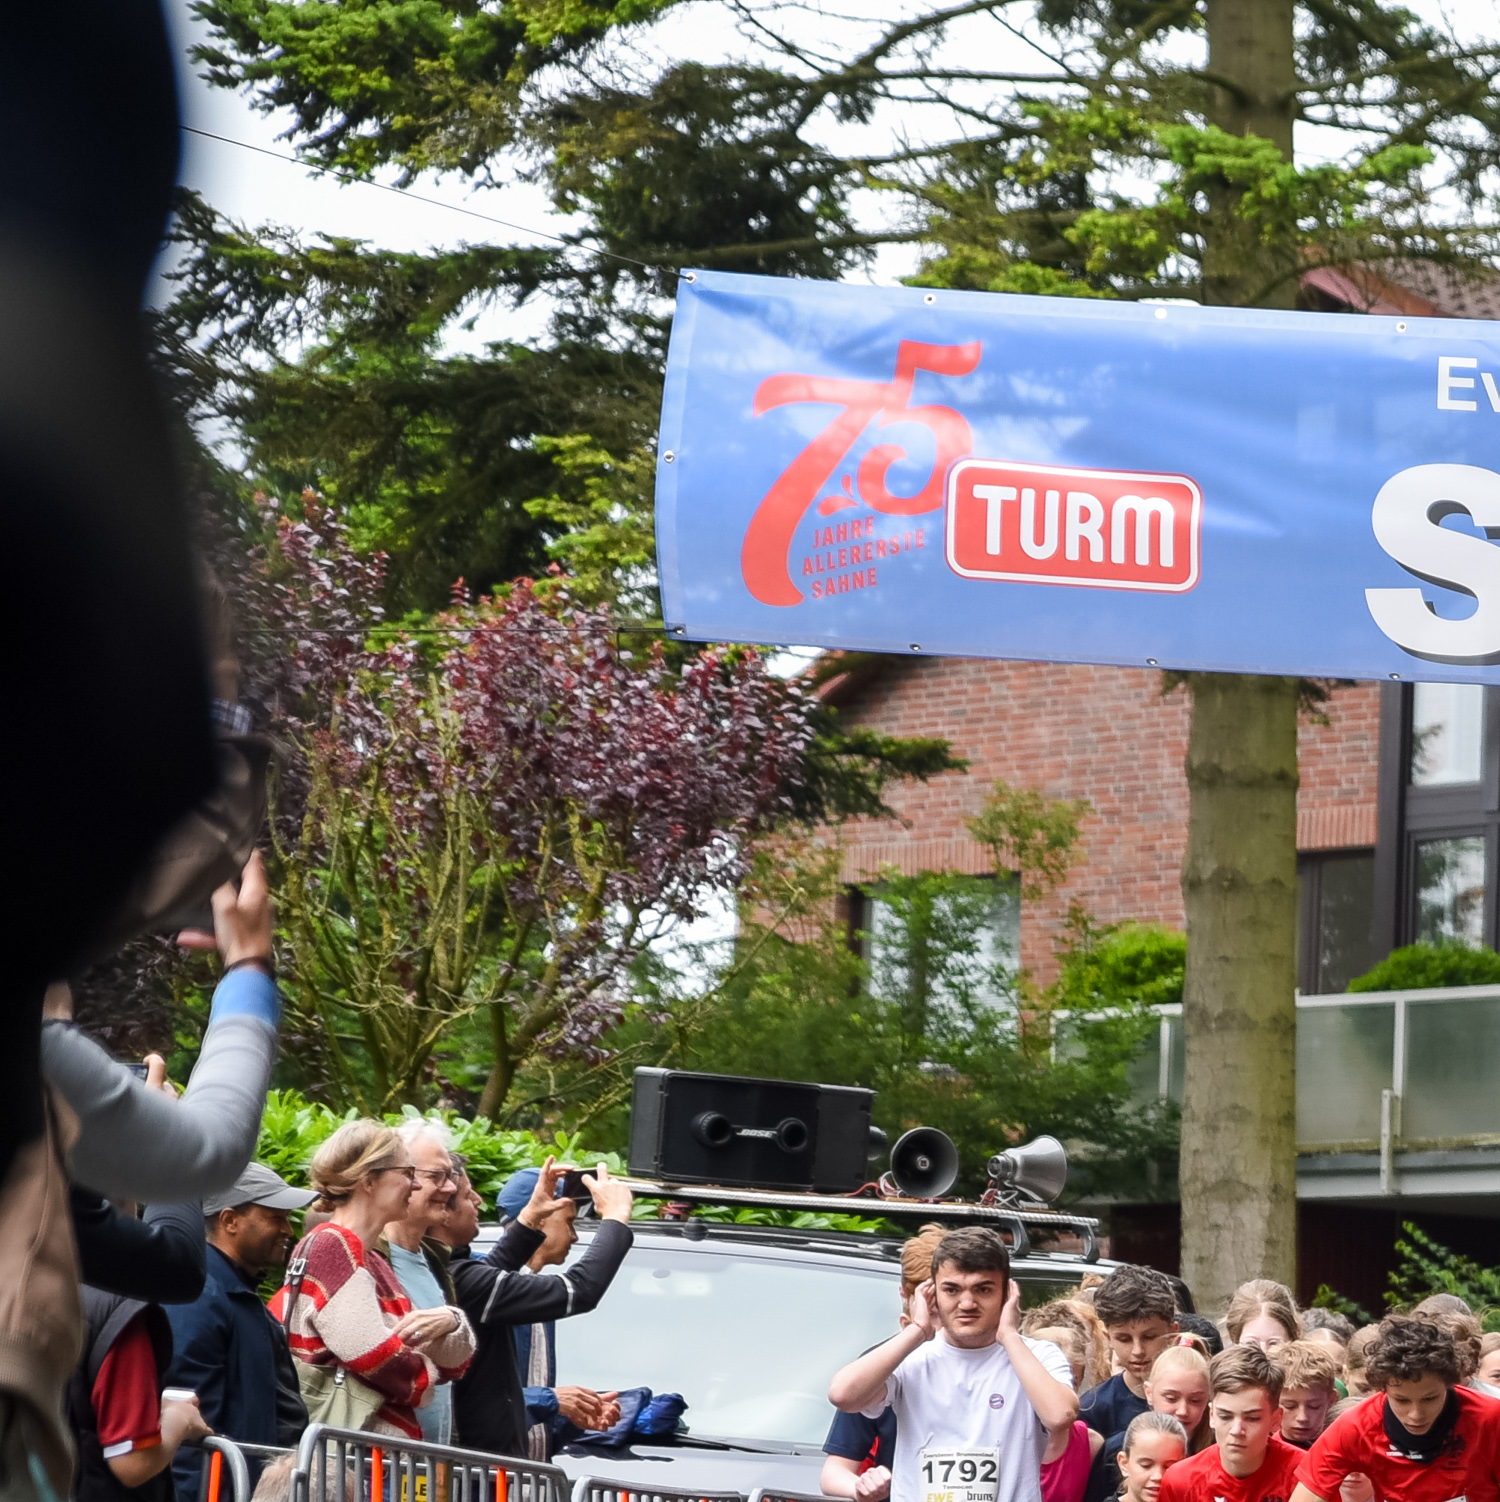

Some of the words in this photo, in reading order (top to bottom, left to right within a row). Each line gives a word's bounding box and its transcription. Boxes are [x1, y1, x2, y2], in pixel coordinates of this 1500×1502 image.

[741, 339, 981, 607] 75
[813, 516, 875, 549] JAHRE
[971, 482, 1176, 569] TURM
[802, 528, 925, 576] ALLERERSTE
[811, 567, 878, 599] SAHNE
[922, 1459, 997, 1484] 1792
[966, 1490, 993, 1502] bruns
